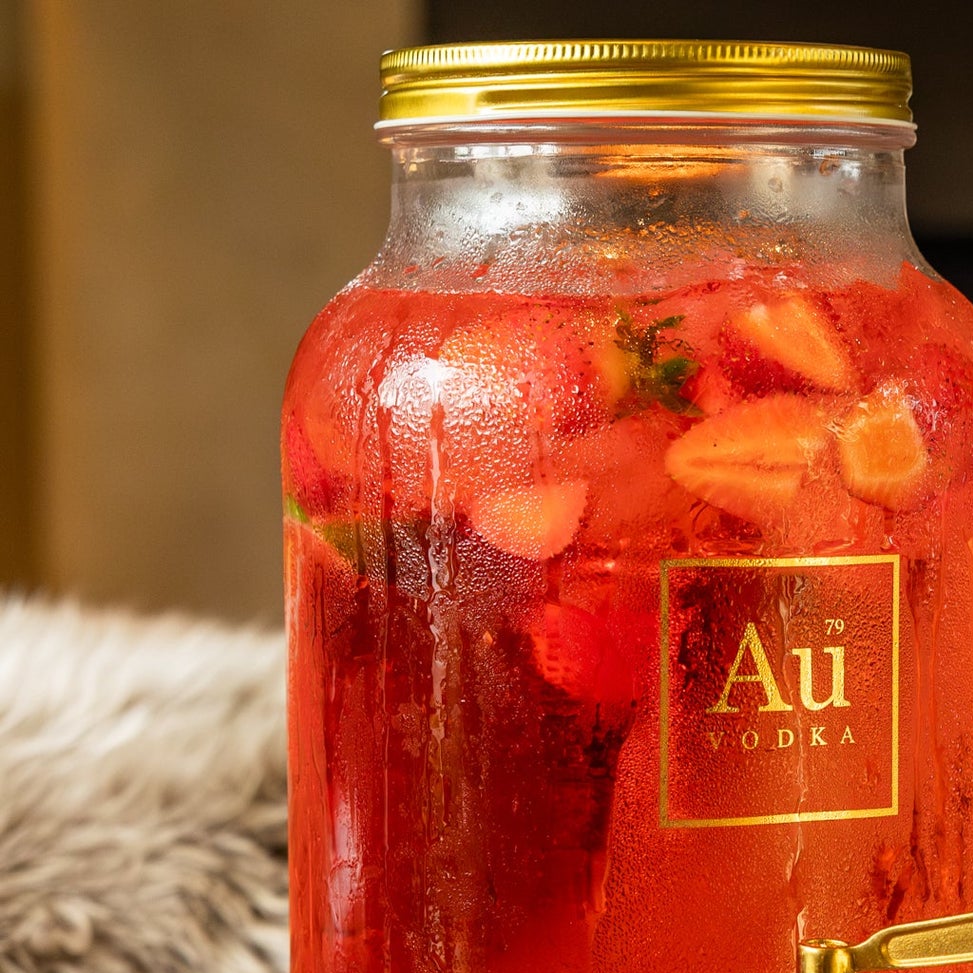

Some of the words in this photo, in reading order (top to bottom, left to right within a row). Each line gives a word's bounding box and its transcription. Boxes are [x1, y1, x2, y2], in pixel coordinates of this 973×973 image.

[825, 618, 845, 635] 79
[705, 621, 851, 714] Au
[708, 725, 856, 751] VODKA
